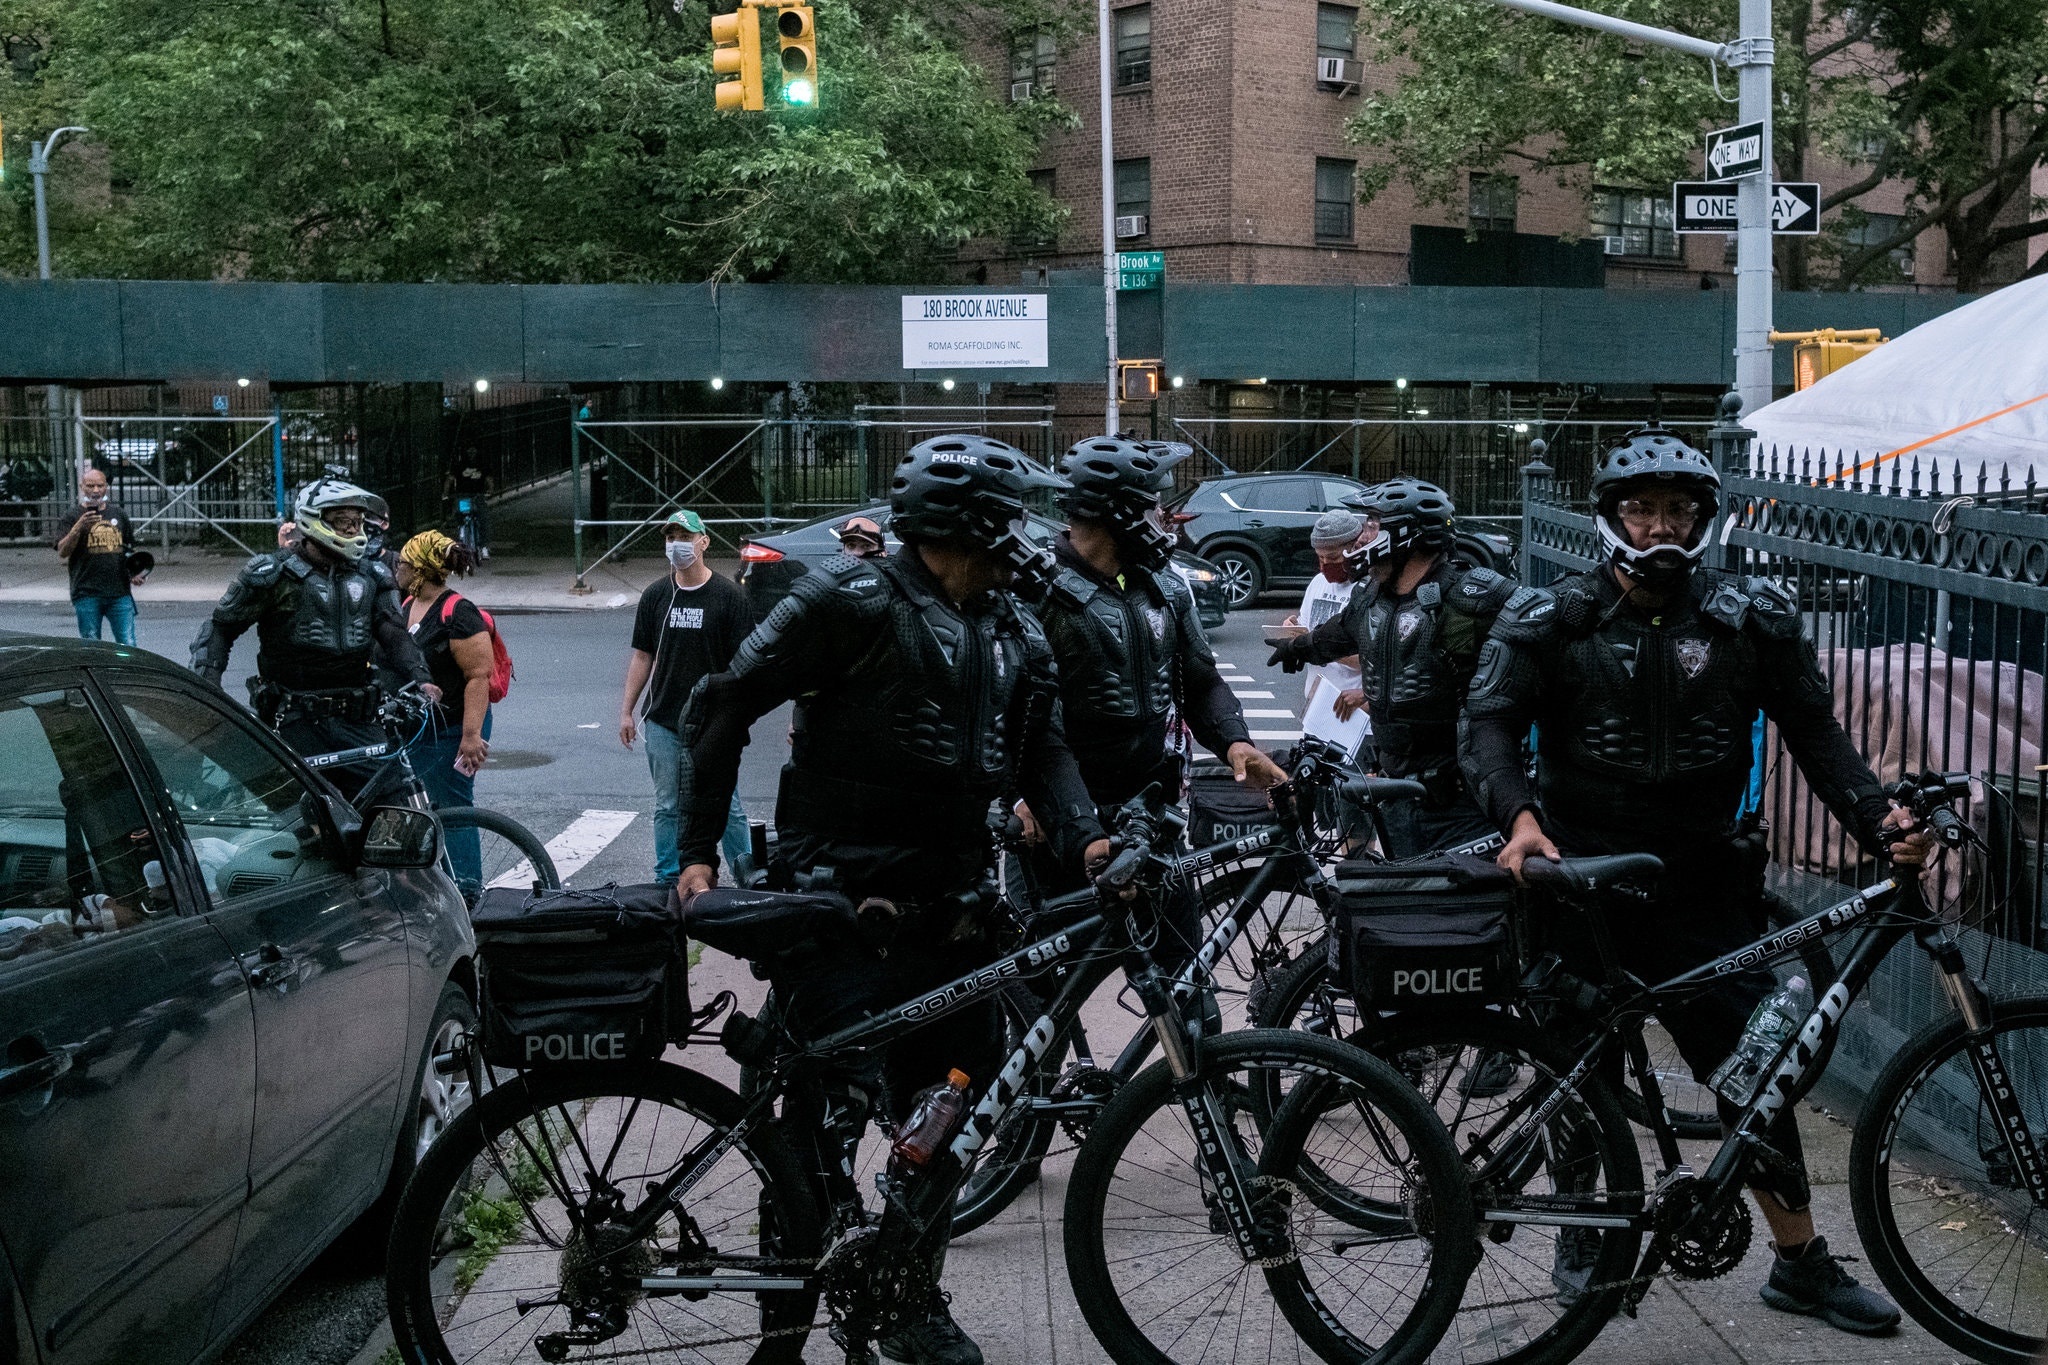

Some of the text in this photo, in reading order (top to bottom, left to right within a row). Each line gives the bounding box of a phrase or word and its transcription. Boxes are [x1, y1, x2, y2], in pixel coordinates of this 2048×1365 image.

[1715, 139, 1756, 165] ONE WAY
[1697, 198, 1797, 217] ONE AY
[1121, 255, 1149, 268] Brook
[1122, 274, 1128, 287] E
[1132, 274, 1147, 287] 136
[923, 299, 1028, 318] 180 BROOK AVENUE
[928, 340, 1023, 350] ROMA SCAFFOLDING INC.
[931, 453, 978, 466] POLICE
[850, 578, 878, 589] FOX
[671, 607, 704, 616] ALL POWER
[1529, 603, 1554, 618] FOX
[365, 745, 386, 757] SRG
[1236, 832, 1270, 855] SRG
[1715, 898, 1868, 976] POLICE SRG
[1173, 917, 1238, 1000] YPD
[900, 935, 1070, 1020] POLICE SRG
[1393, 967, 1483, 995] POLICE
[525, 1032, 626, 1061] POLICE
[1751, 982, 1850, 1128] NYPD
[1980, 1044, 2009, 1100] NYPD
[949, 1015, 1055, 1169] NYPD
[1520, 1089, 1563, 1138] CODE
[669, 1147, 721, 1202] CODE
[1187, 1098, 1257, 1257] NYPD POLICE
